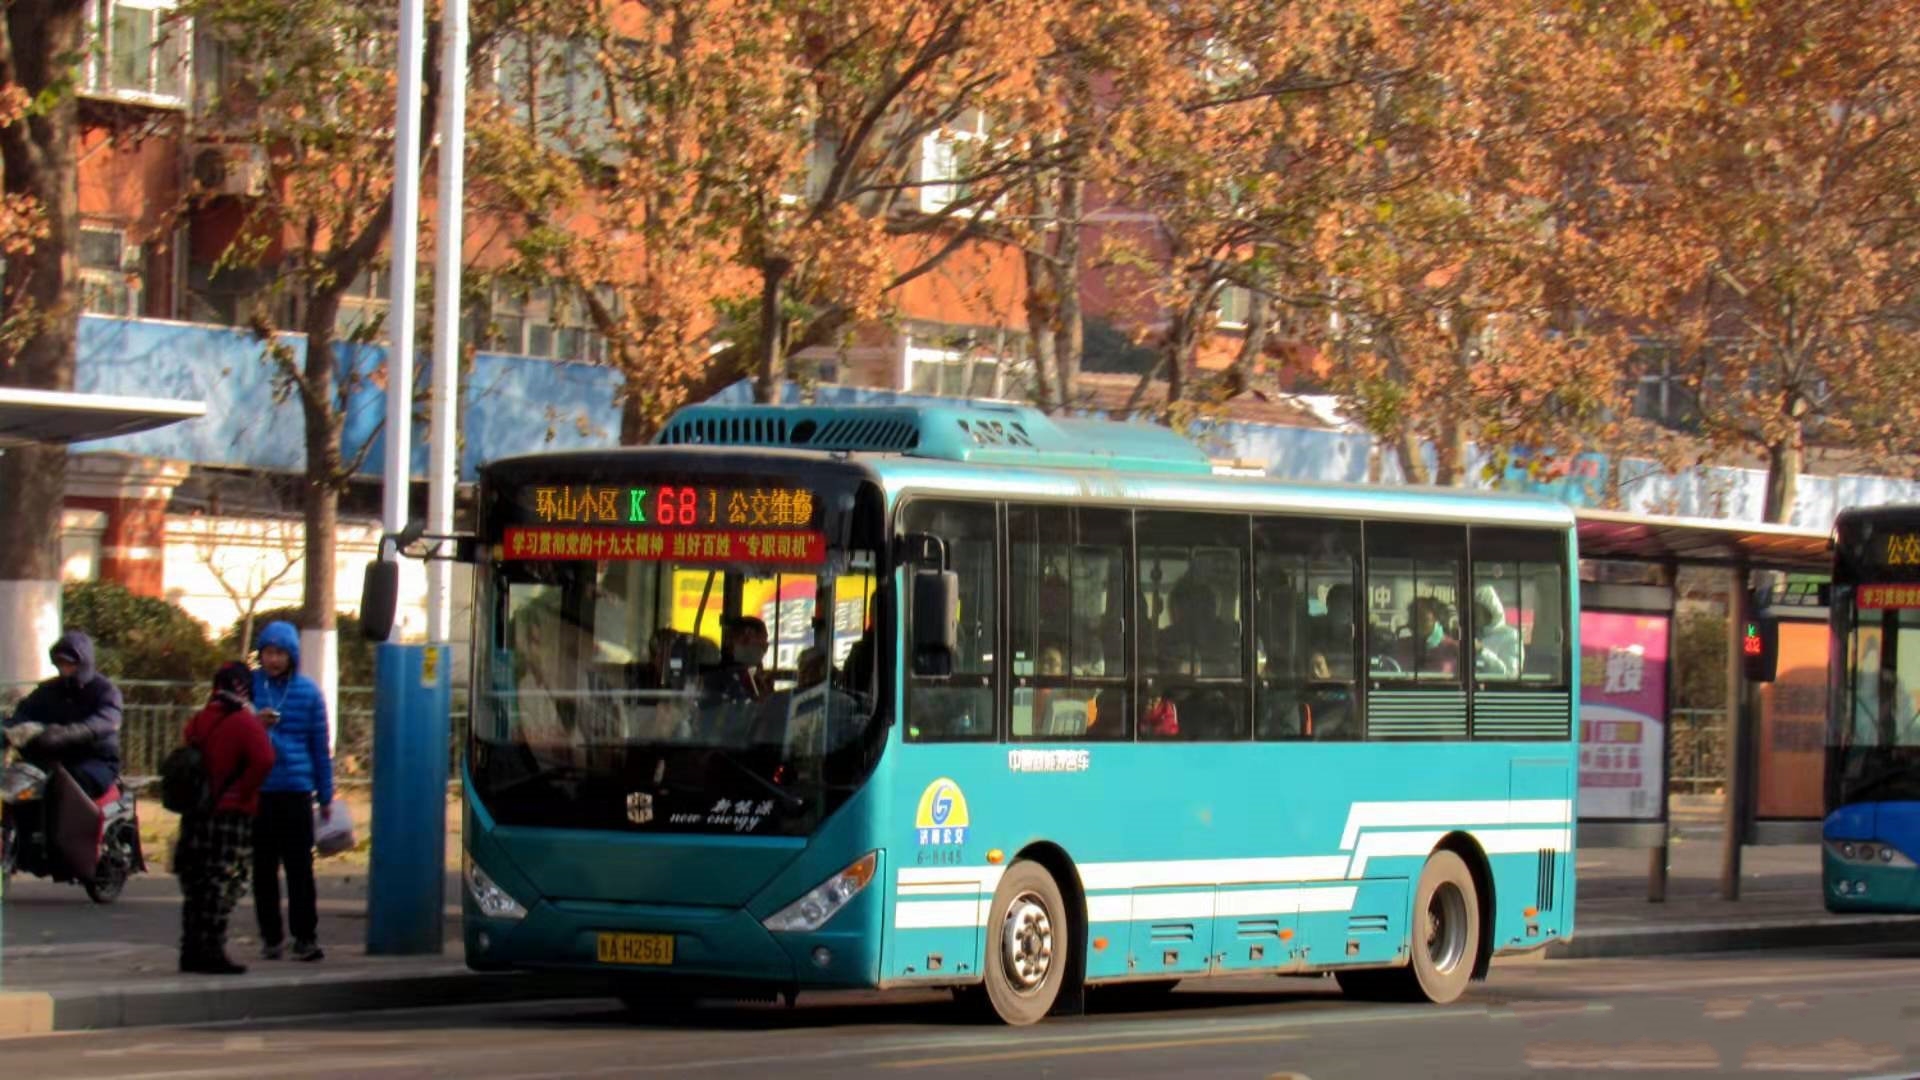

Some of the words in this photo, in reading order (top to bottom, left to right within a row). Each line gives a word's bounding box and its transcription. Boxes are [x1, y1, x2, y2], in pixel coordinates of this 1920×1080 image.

[535, 486, 619, 522] 环山小区
[629, 489, 646, 522] K
[658, 487, 697, 524] 68
[512, 533, 664, 556] 学习贯彻党的十九大精神
[1887, 534, 1920, 565] 公交
